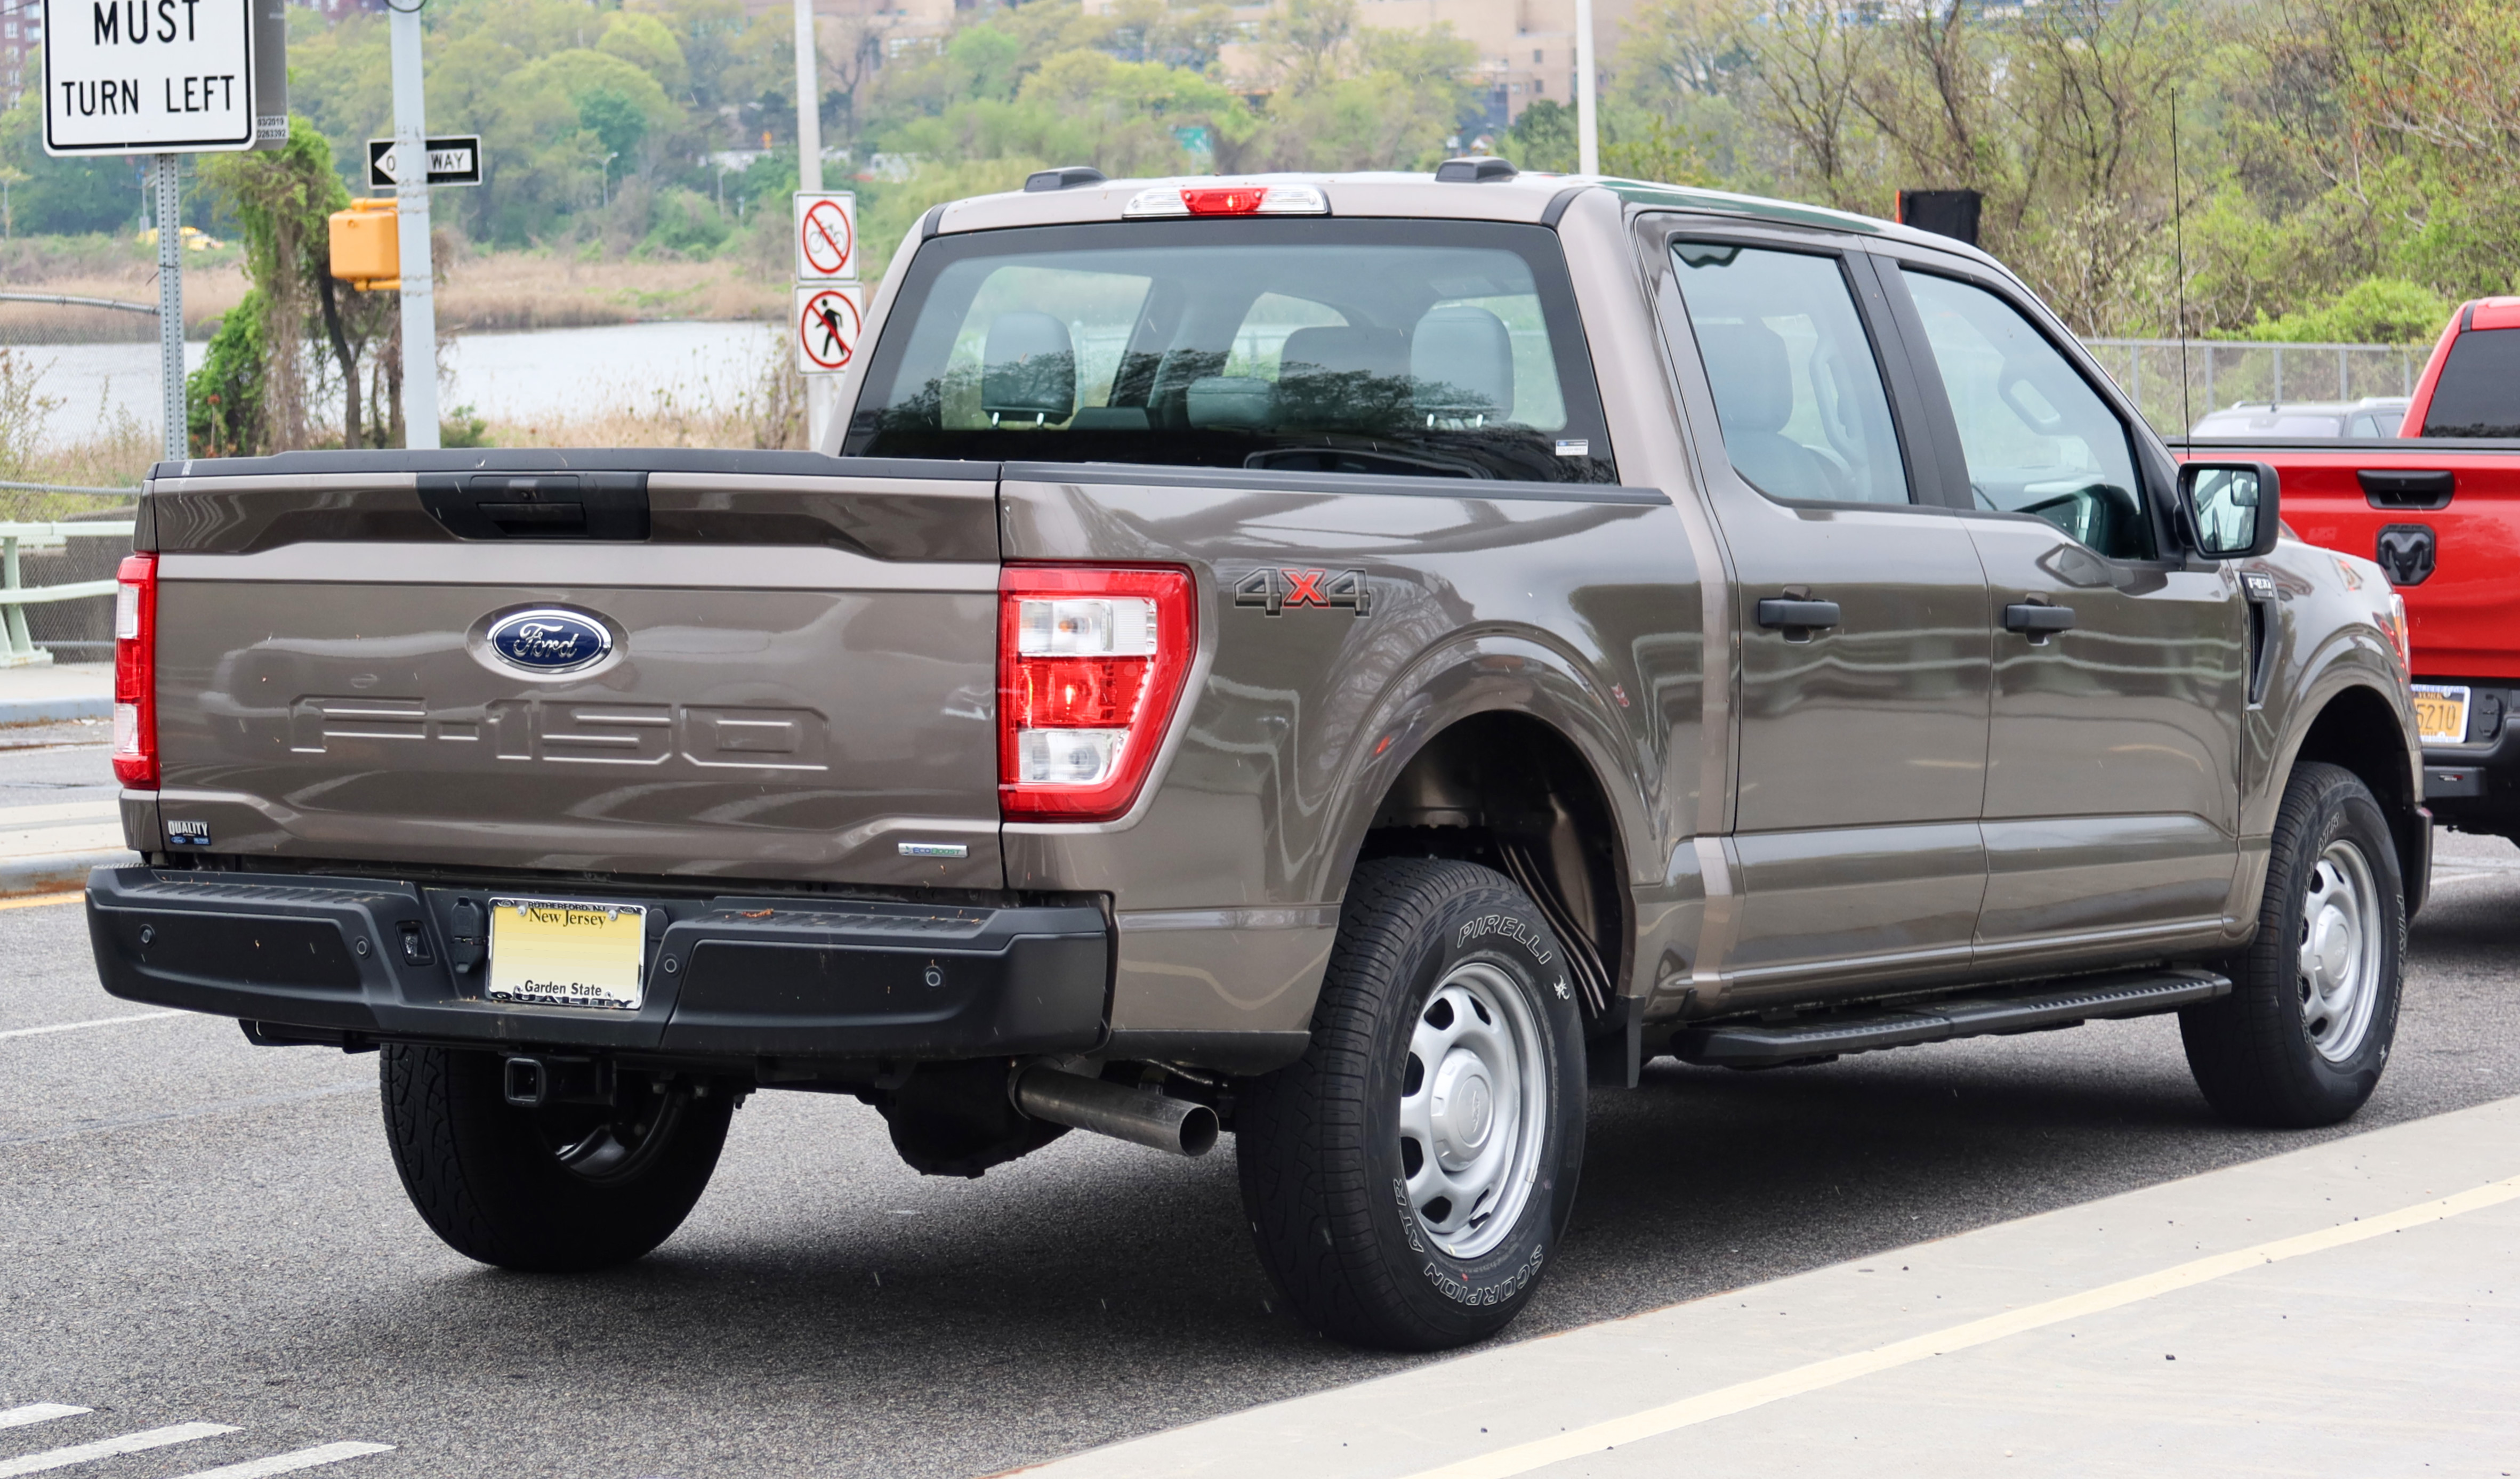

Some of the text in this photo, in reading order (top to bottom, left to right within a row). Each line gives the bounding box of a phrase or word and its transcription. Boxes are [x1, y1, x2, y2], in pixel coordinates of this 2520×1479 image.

[94, 0, 199, 45] MUST
[61, 75, 235, 116] TURN LEFT
[431, 152, 464, 170] WAY
[513, 623, 579, 658] Ford
[288, 694, 829, 771] F-150
[168, 821, 208, 836] QUALITY
[529, 908, 561, 923] New
[563, 910, 606, 928] Jersey
[1456, 915, 1552, 965] PIRELLI
[491, 991, 635, 1008] QUALITY
[525, 980, 602, 997] Garden State
[1392, 1178, 1424, 1253] ATR
[1423, 1244, 1543, 1306] SCORPION
